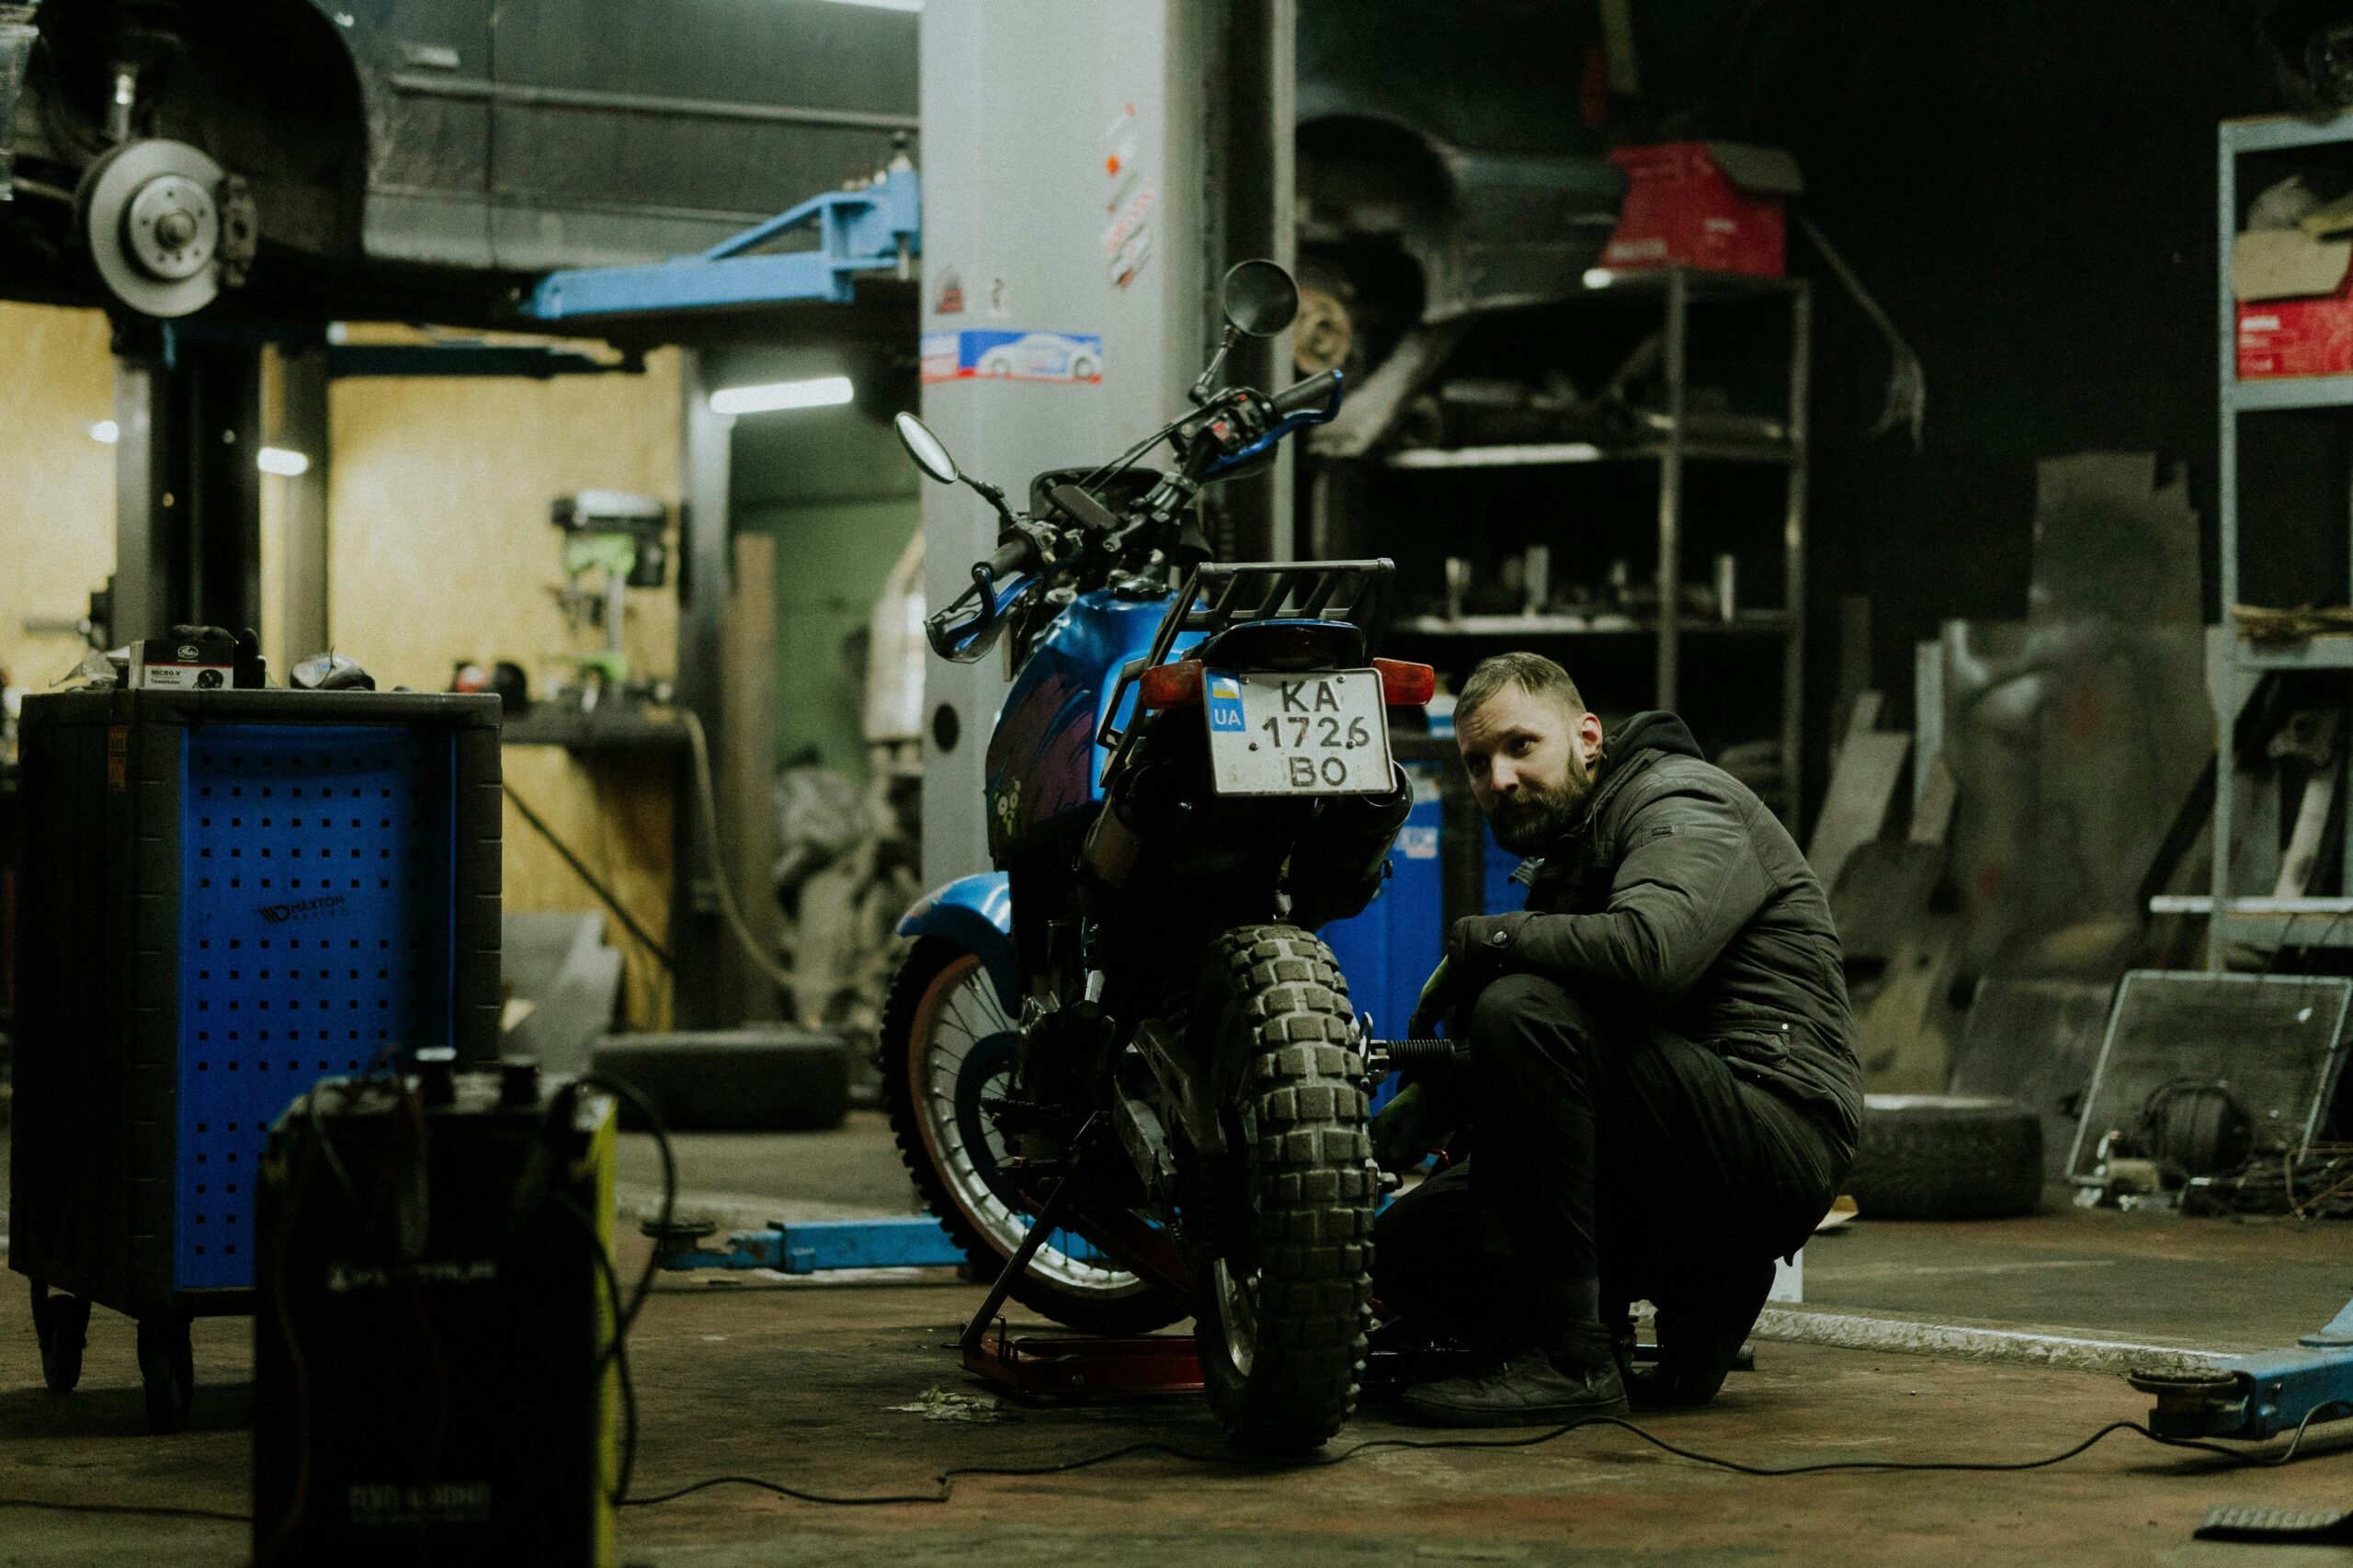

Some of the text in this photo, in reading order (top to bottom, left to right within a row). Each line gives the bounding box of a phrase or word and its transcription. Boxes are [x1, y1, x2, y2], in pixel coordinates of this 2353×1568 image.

[1281, 680, 1340, 712] KA
[1214, 710, 1241, 726] UA
[1263, 717, 1370, 747] 1726
[1290, 756, 1347, 786] BO
[290, 896, 345, 913] MAXTON
